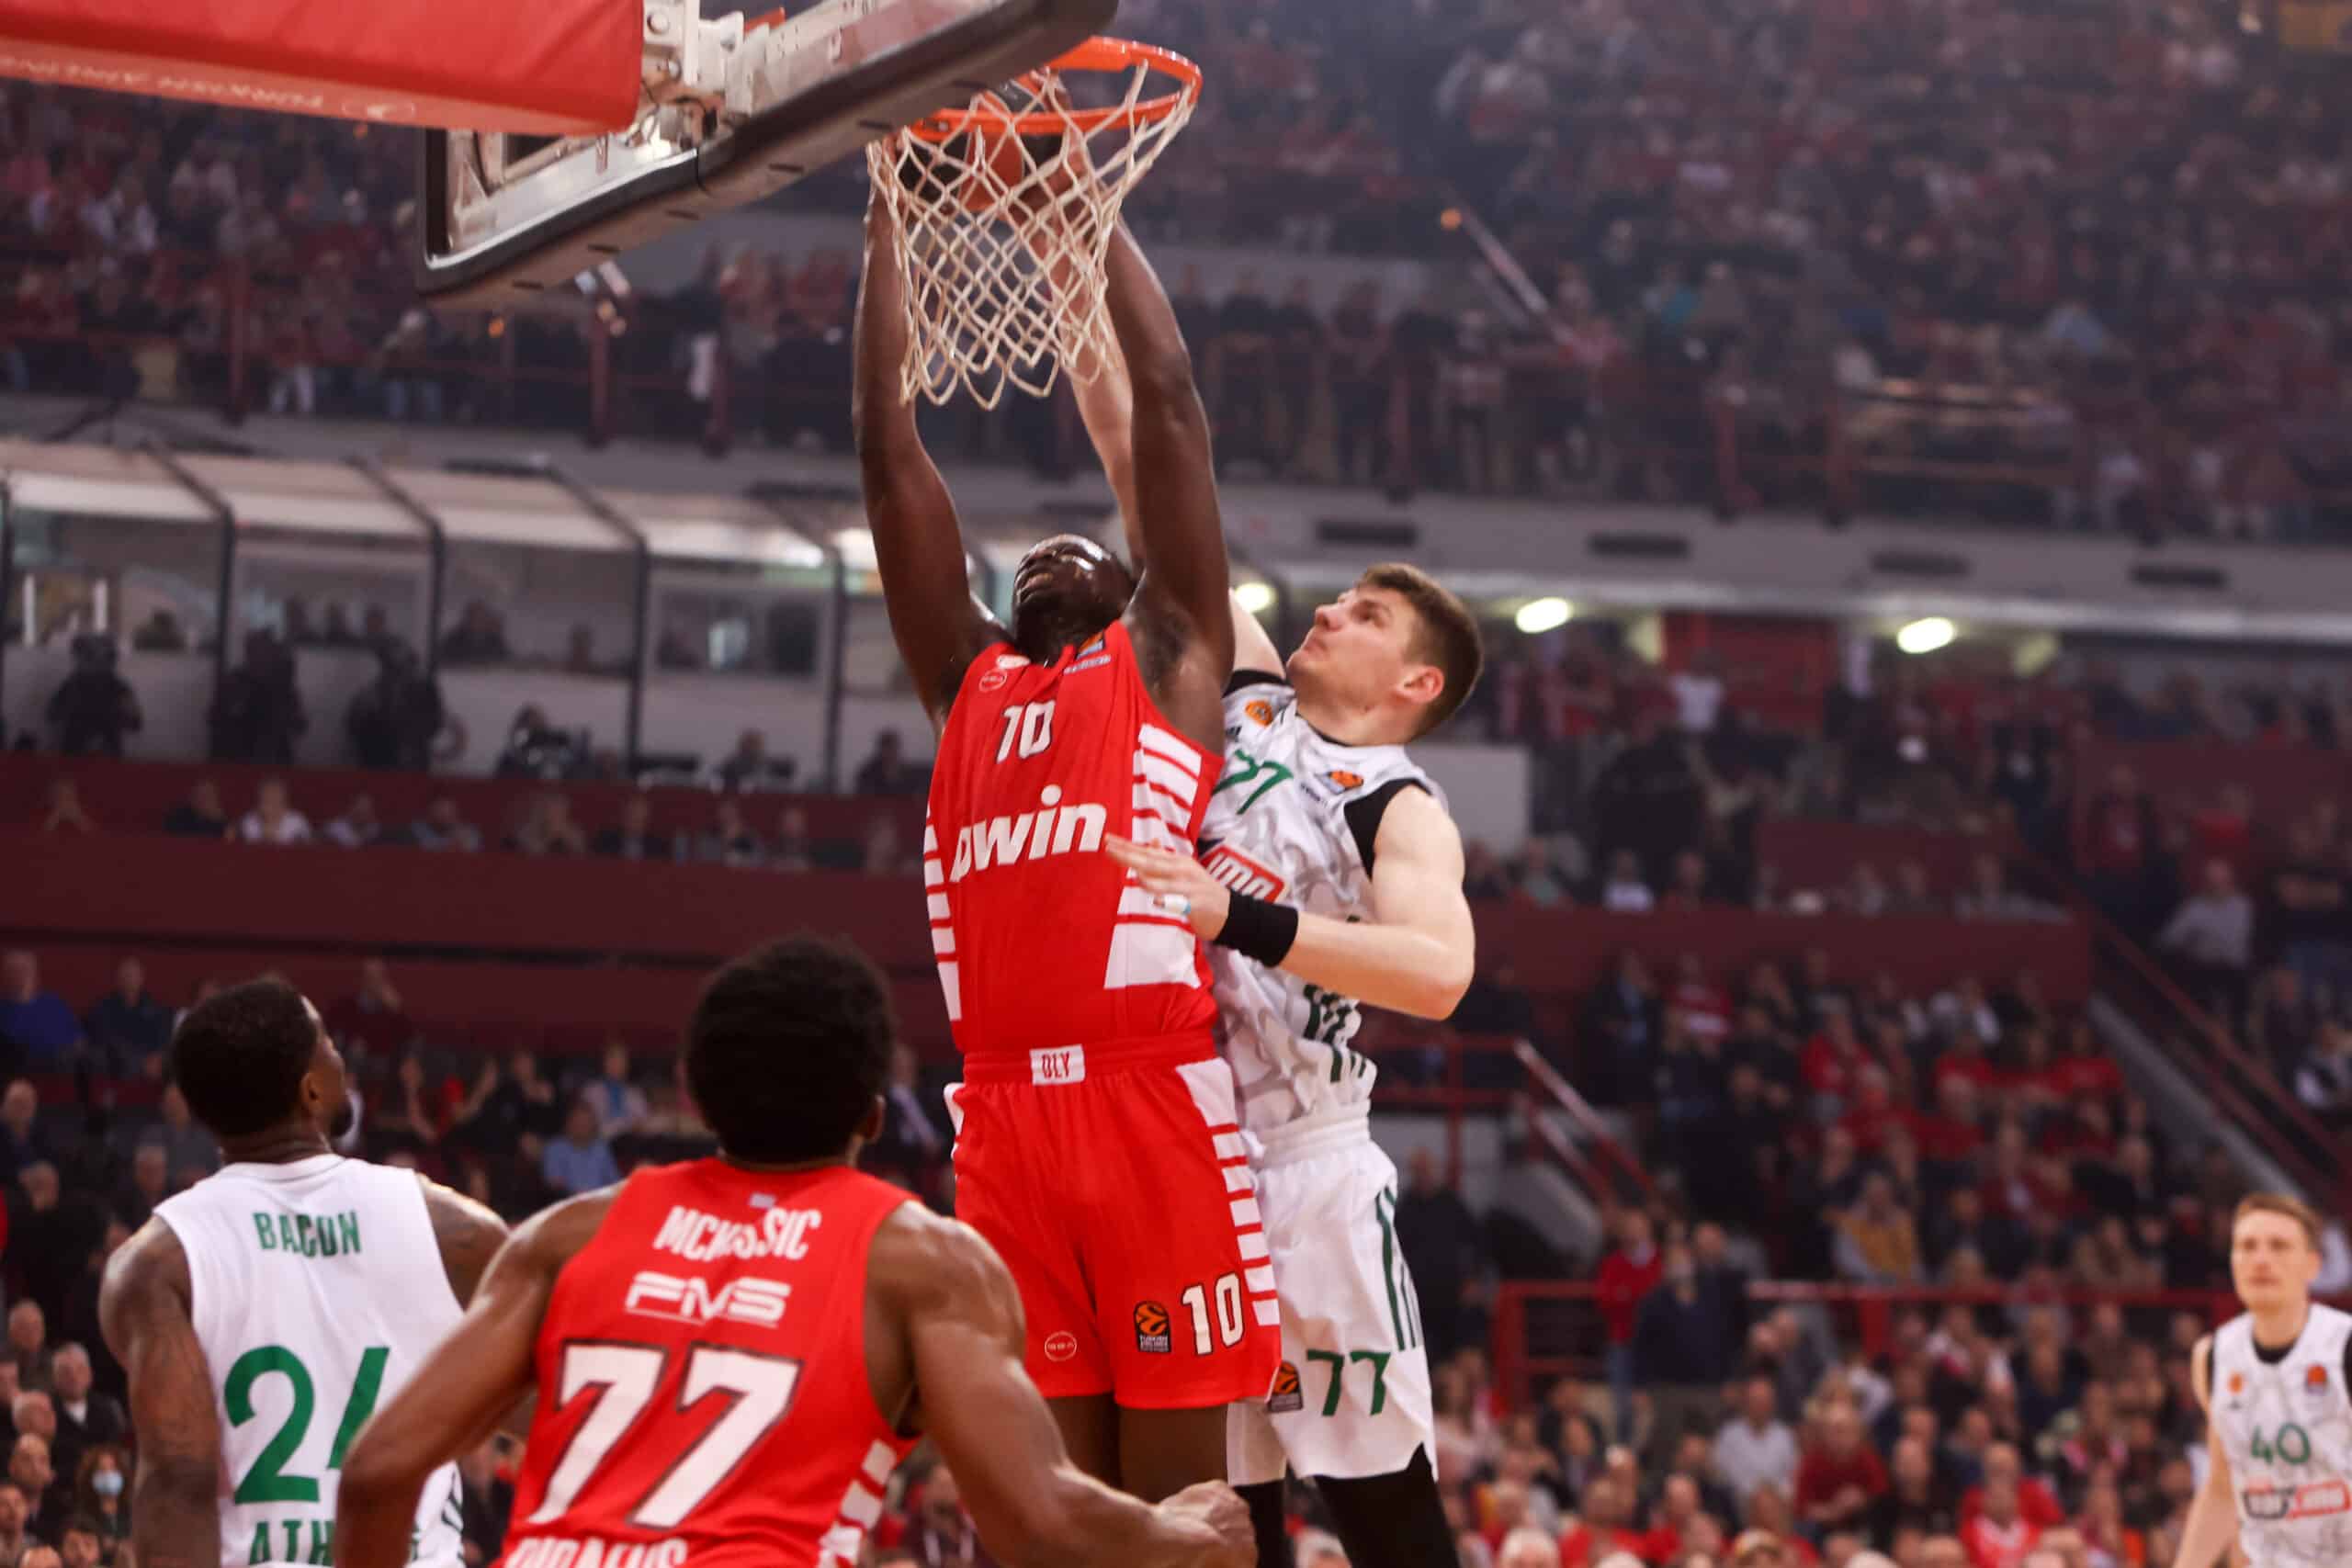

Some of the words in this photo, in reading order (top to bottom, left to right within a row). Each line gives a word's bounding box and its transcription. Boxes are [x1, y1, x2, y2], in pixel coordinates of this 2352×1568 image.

[995, 698, 1057, 764] 10
[1041, 1050, 1070, 1078] OLY
[252, 1210, 362, 1258] BACON
[1181, 1271, 1245, 1356] 10
[1306, 1348, 1391, 1416] 77
[522, 1338, 805, 1530] 77
[2251, 1421, 2312, 1465] 40
